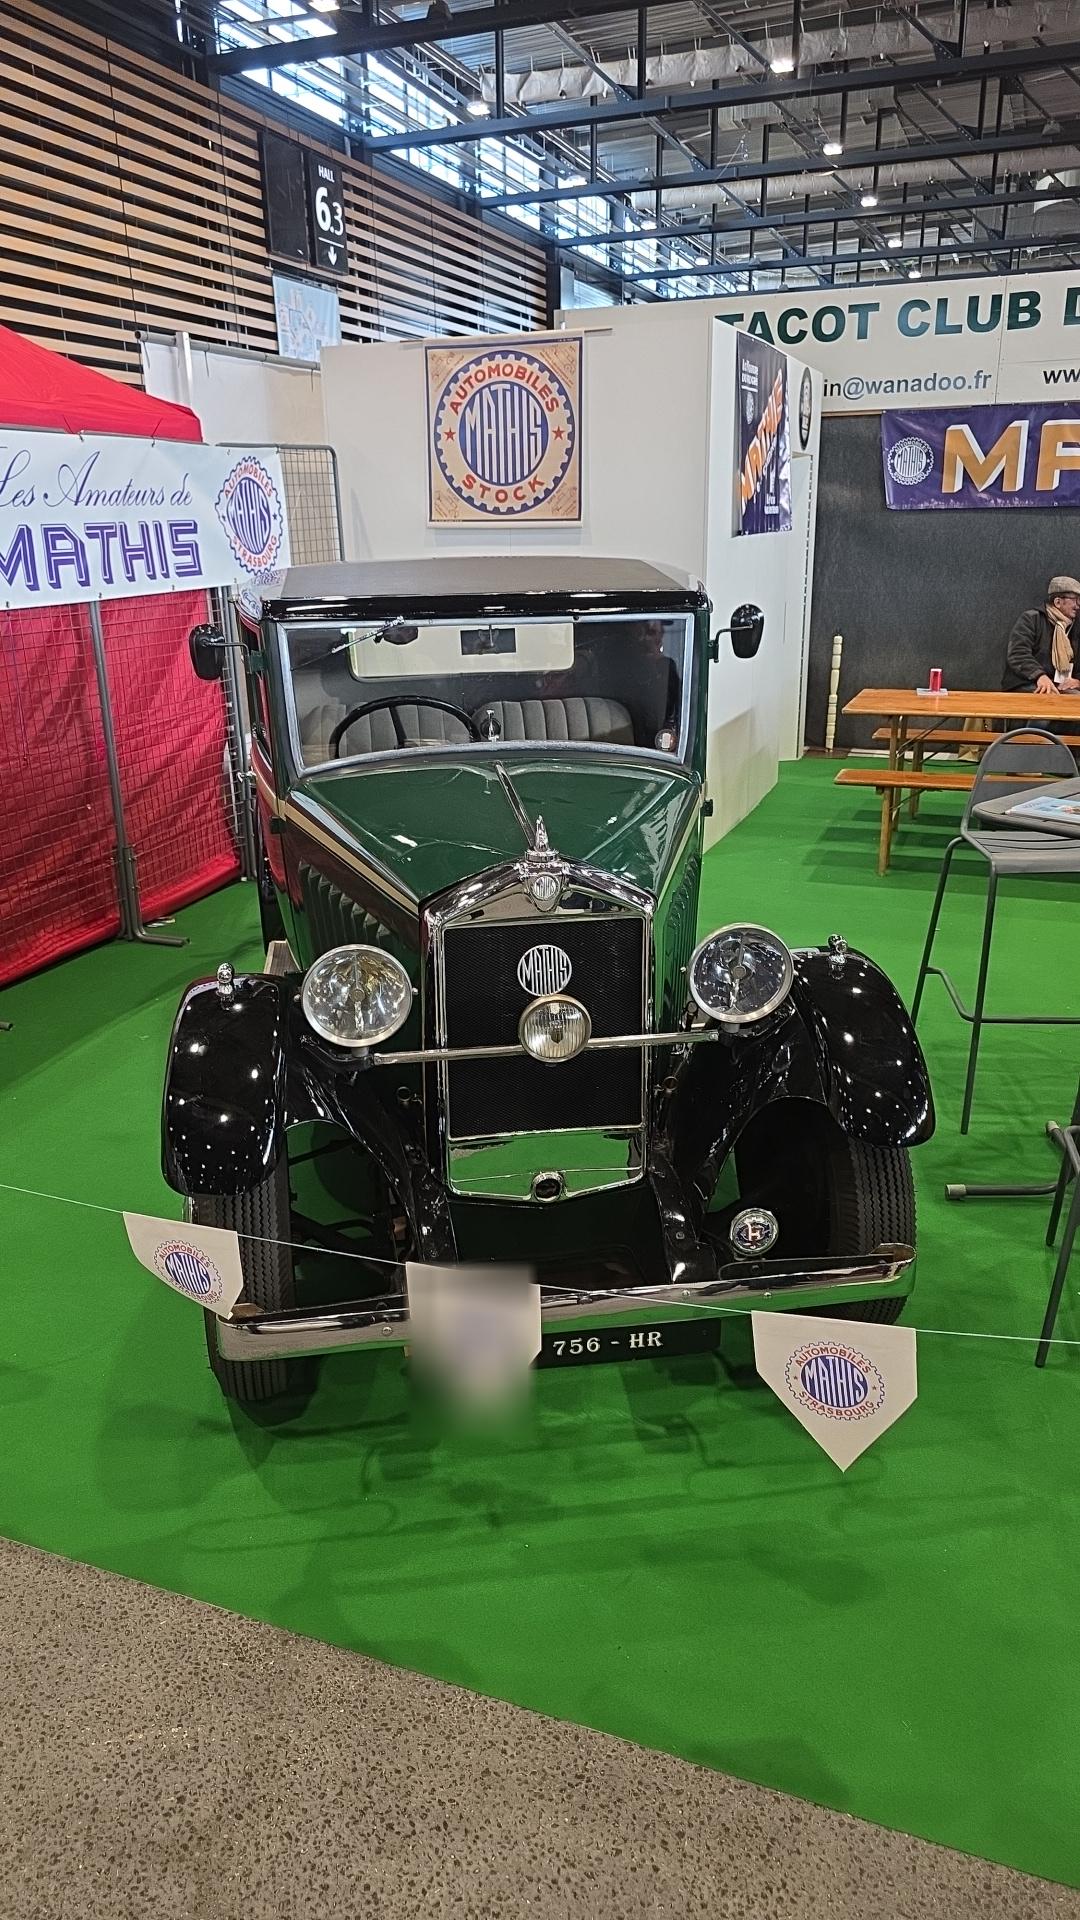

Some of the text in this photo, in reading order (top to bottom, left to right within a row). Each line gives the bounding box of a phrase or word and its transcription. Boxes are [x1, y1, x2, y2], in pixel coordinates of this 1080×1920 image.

[318, 165, 335, 182] HALL
[315, 186, 344, 236] 6.3
[897, 290, 1042, 338] CLUB
[450, 363, 560, 416] AUTOMOBILES
[465, 382, 543, 485] MATHIS
[0, 449, 193, 508] Les Amateurs de
[224, 463, 273, 499] AUTOMOBILES
[462, 473, 545, 504] STOCK
[0, 519, 203, 591] MATHIS
[232, 535, 278, 568] STRASBOURG
[518, 945, 572, 997] MATHIS
[158, 1244, 211, 1268] AUTOMOBILES
[166, 1252, 211, 1294] MATHIS
[169, 1277, 218, 1301] BOURG
[552, 1336, 601, 1356] 756
[629, 1331, 663, 1349] HR
[795, 1347, 872, 1374] AUTOMOBILES
[803, 1355, 866, 1407] MATHIS
[799, 1391, 875, 1417] STRASBOURG
